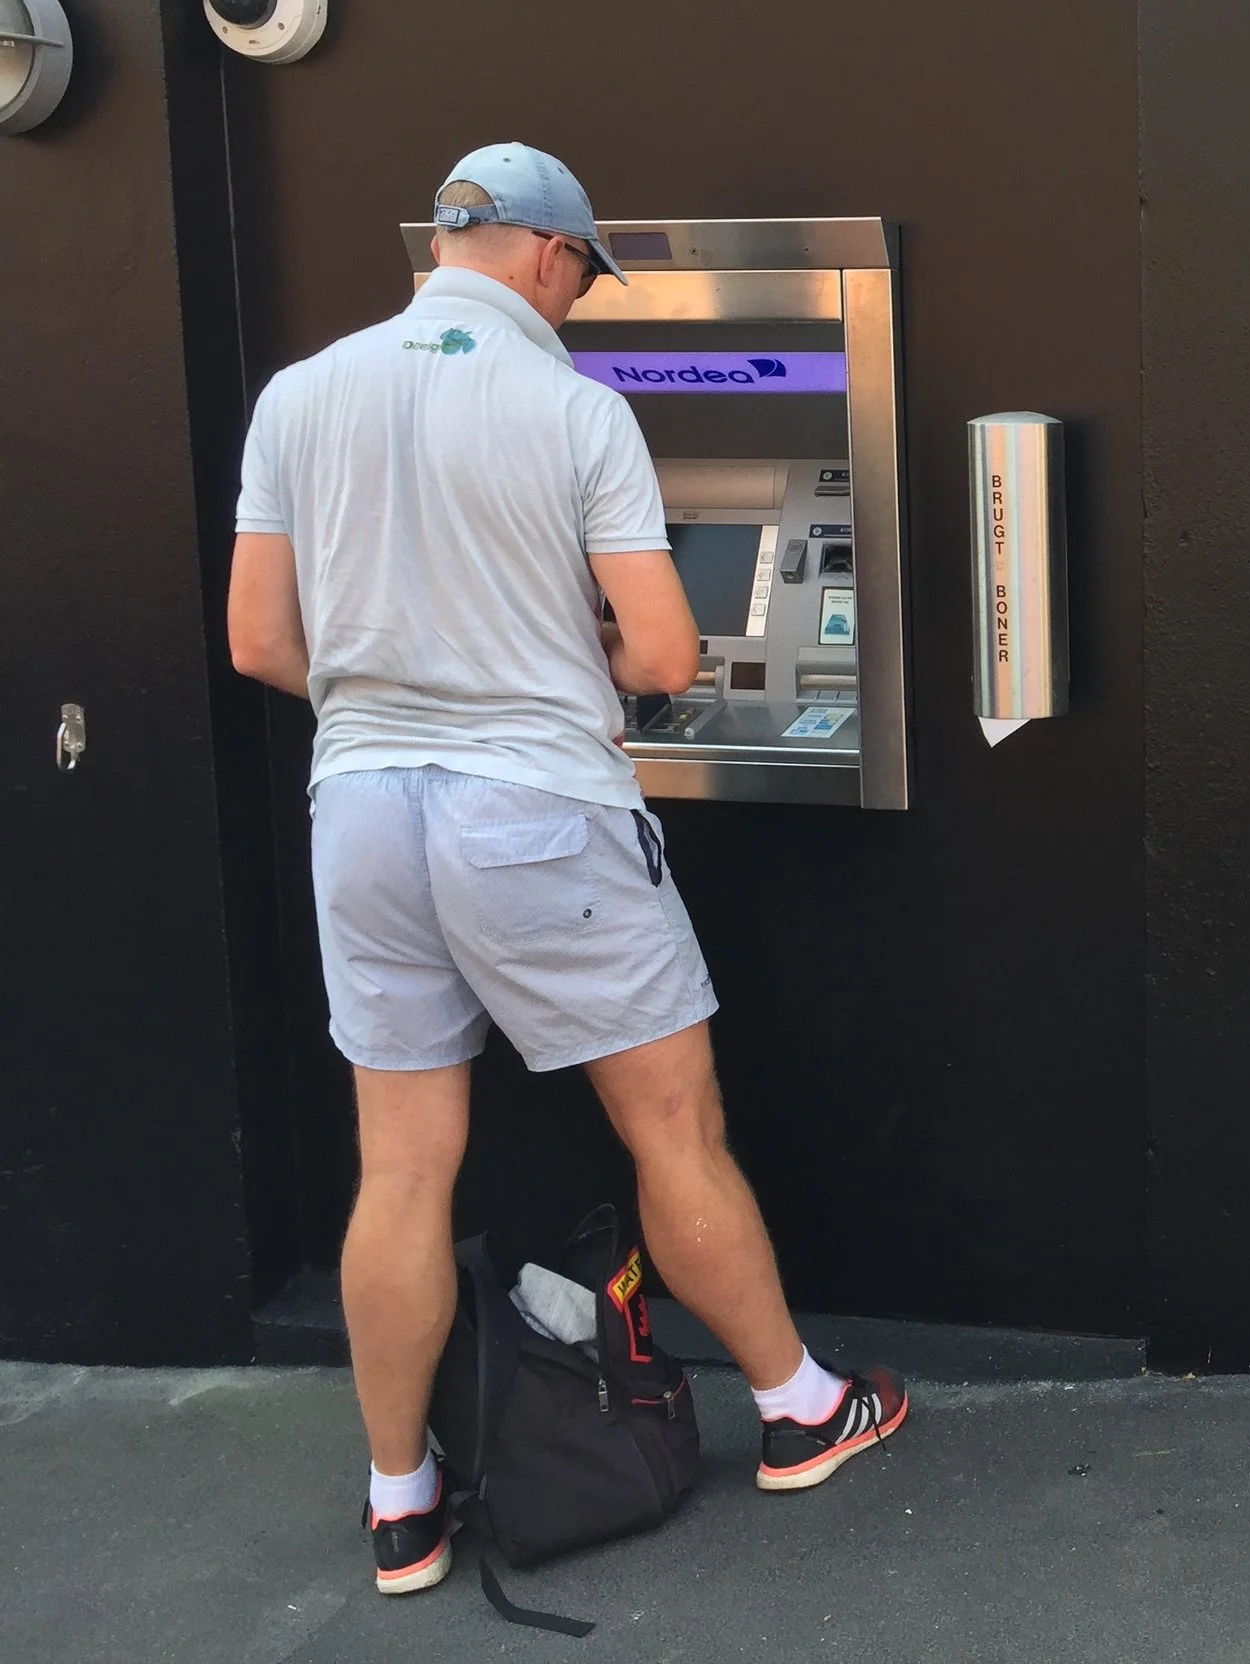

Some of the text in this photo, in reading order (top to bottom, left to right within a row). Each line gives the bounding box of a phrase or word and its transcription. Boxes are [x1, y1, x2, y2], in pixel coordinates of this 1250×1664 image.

[612, 366, 755, 384] Nordea
[992, 475, 1009, 662] BRUGT BONER
